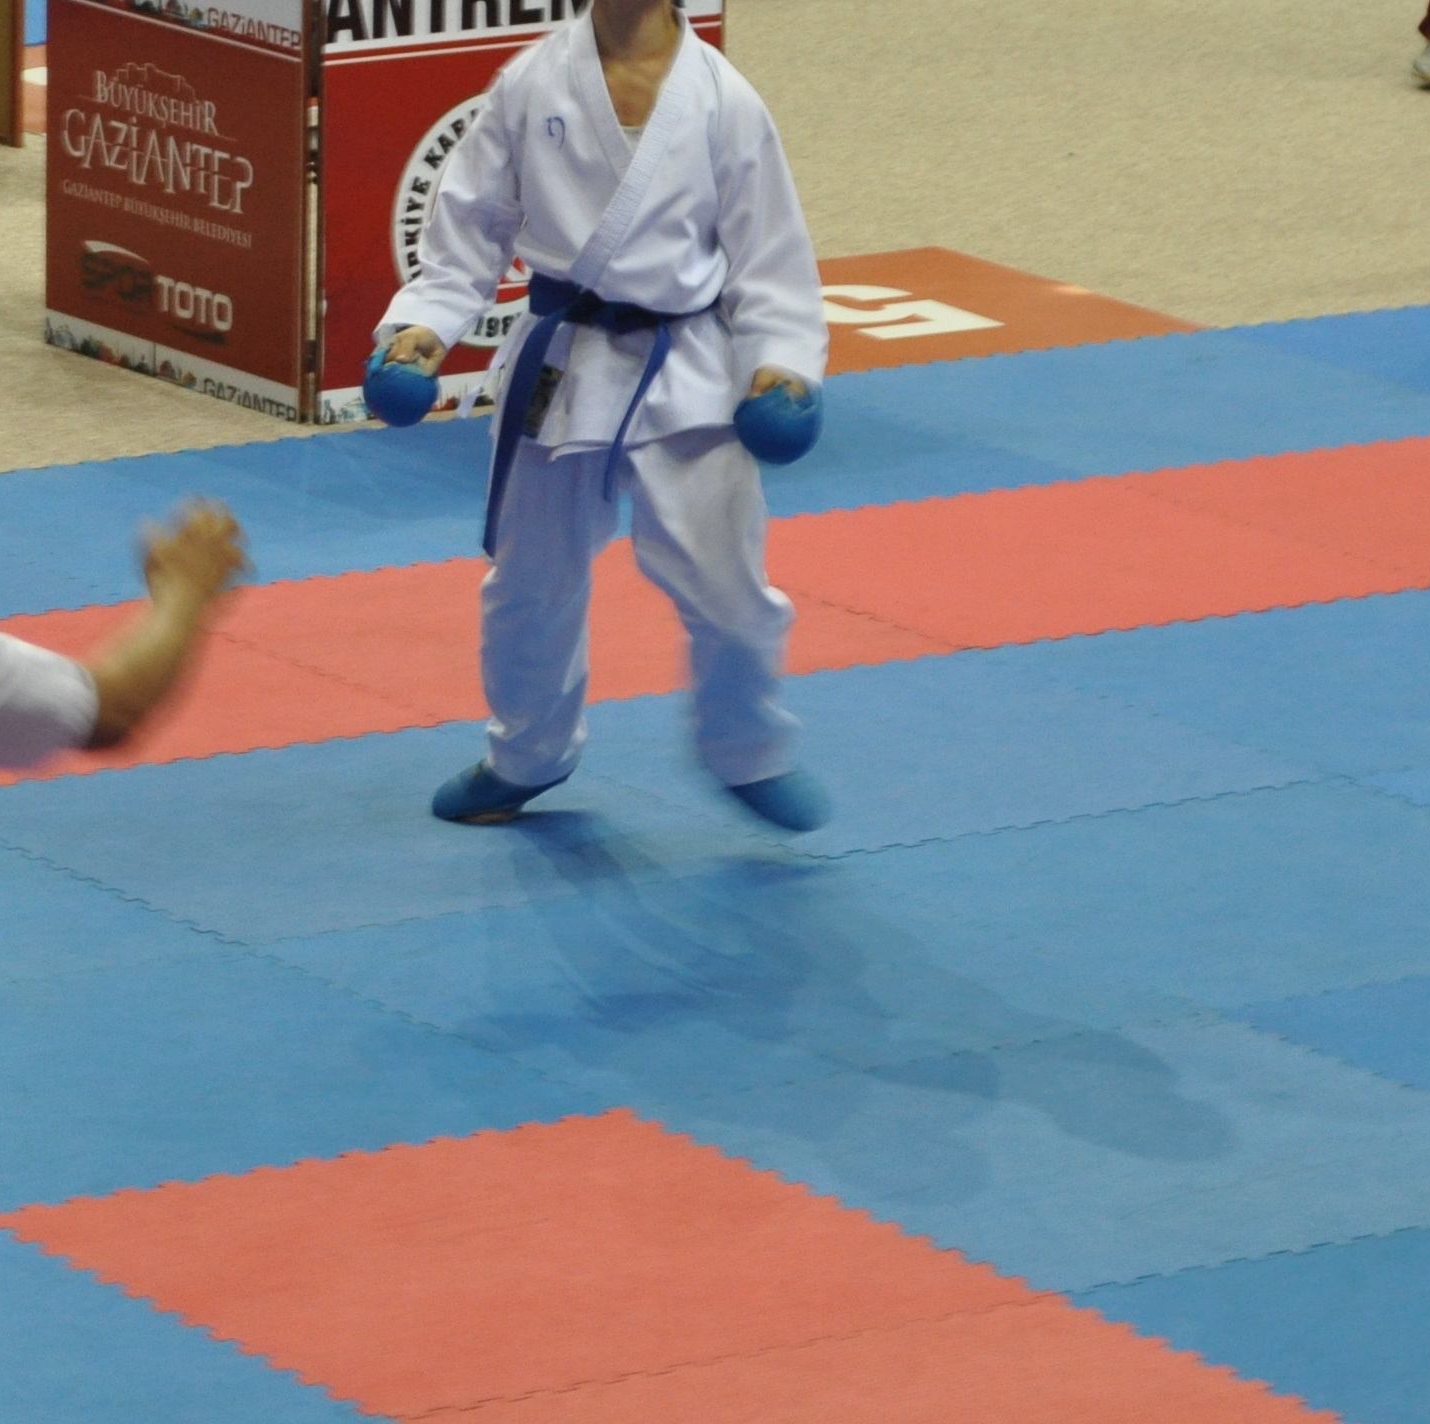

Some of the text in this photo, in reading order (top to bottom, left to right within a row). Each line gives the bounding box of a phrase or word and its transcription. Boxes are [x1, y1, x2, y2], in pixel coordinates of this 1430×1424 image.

[94, 70, 219, 136] BÜYÜKŞEHİR
[63, 108, 254, 215] GAZİANTEP
[156, 275, 234, 332] TOTO
